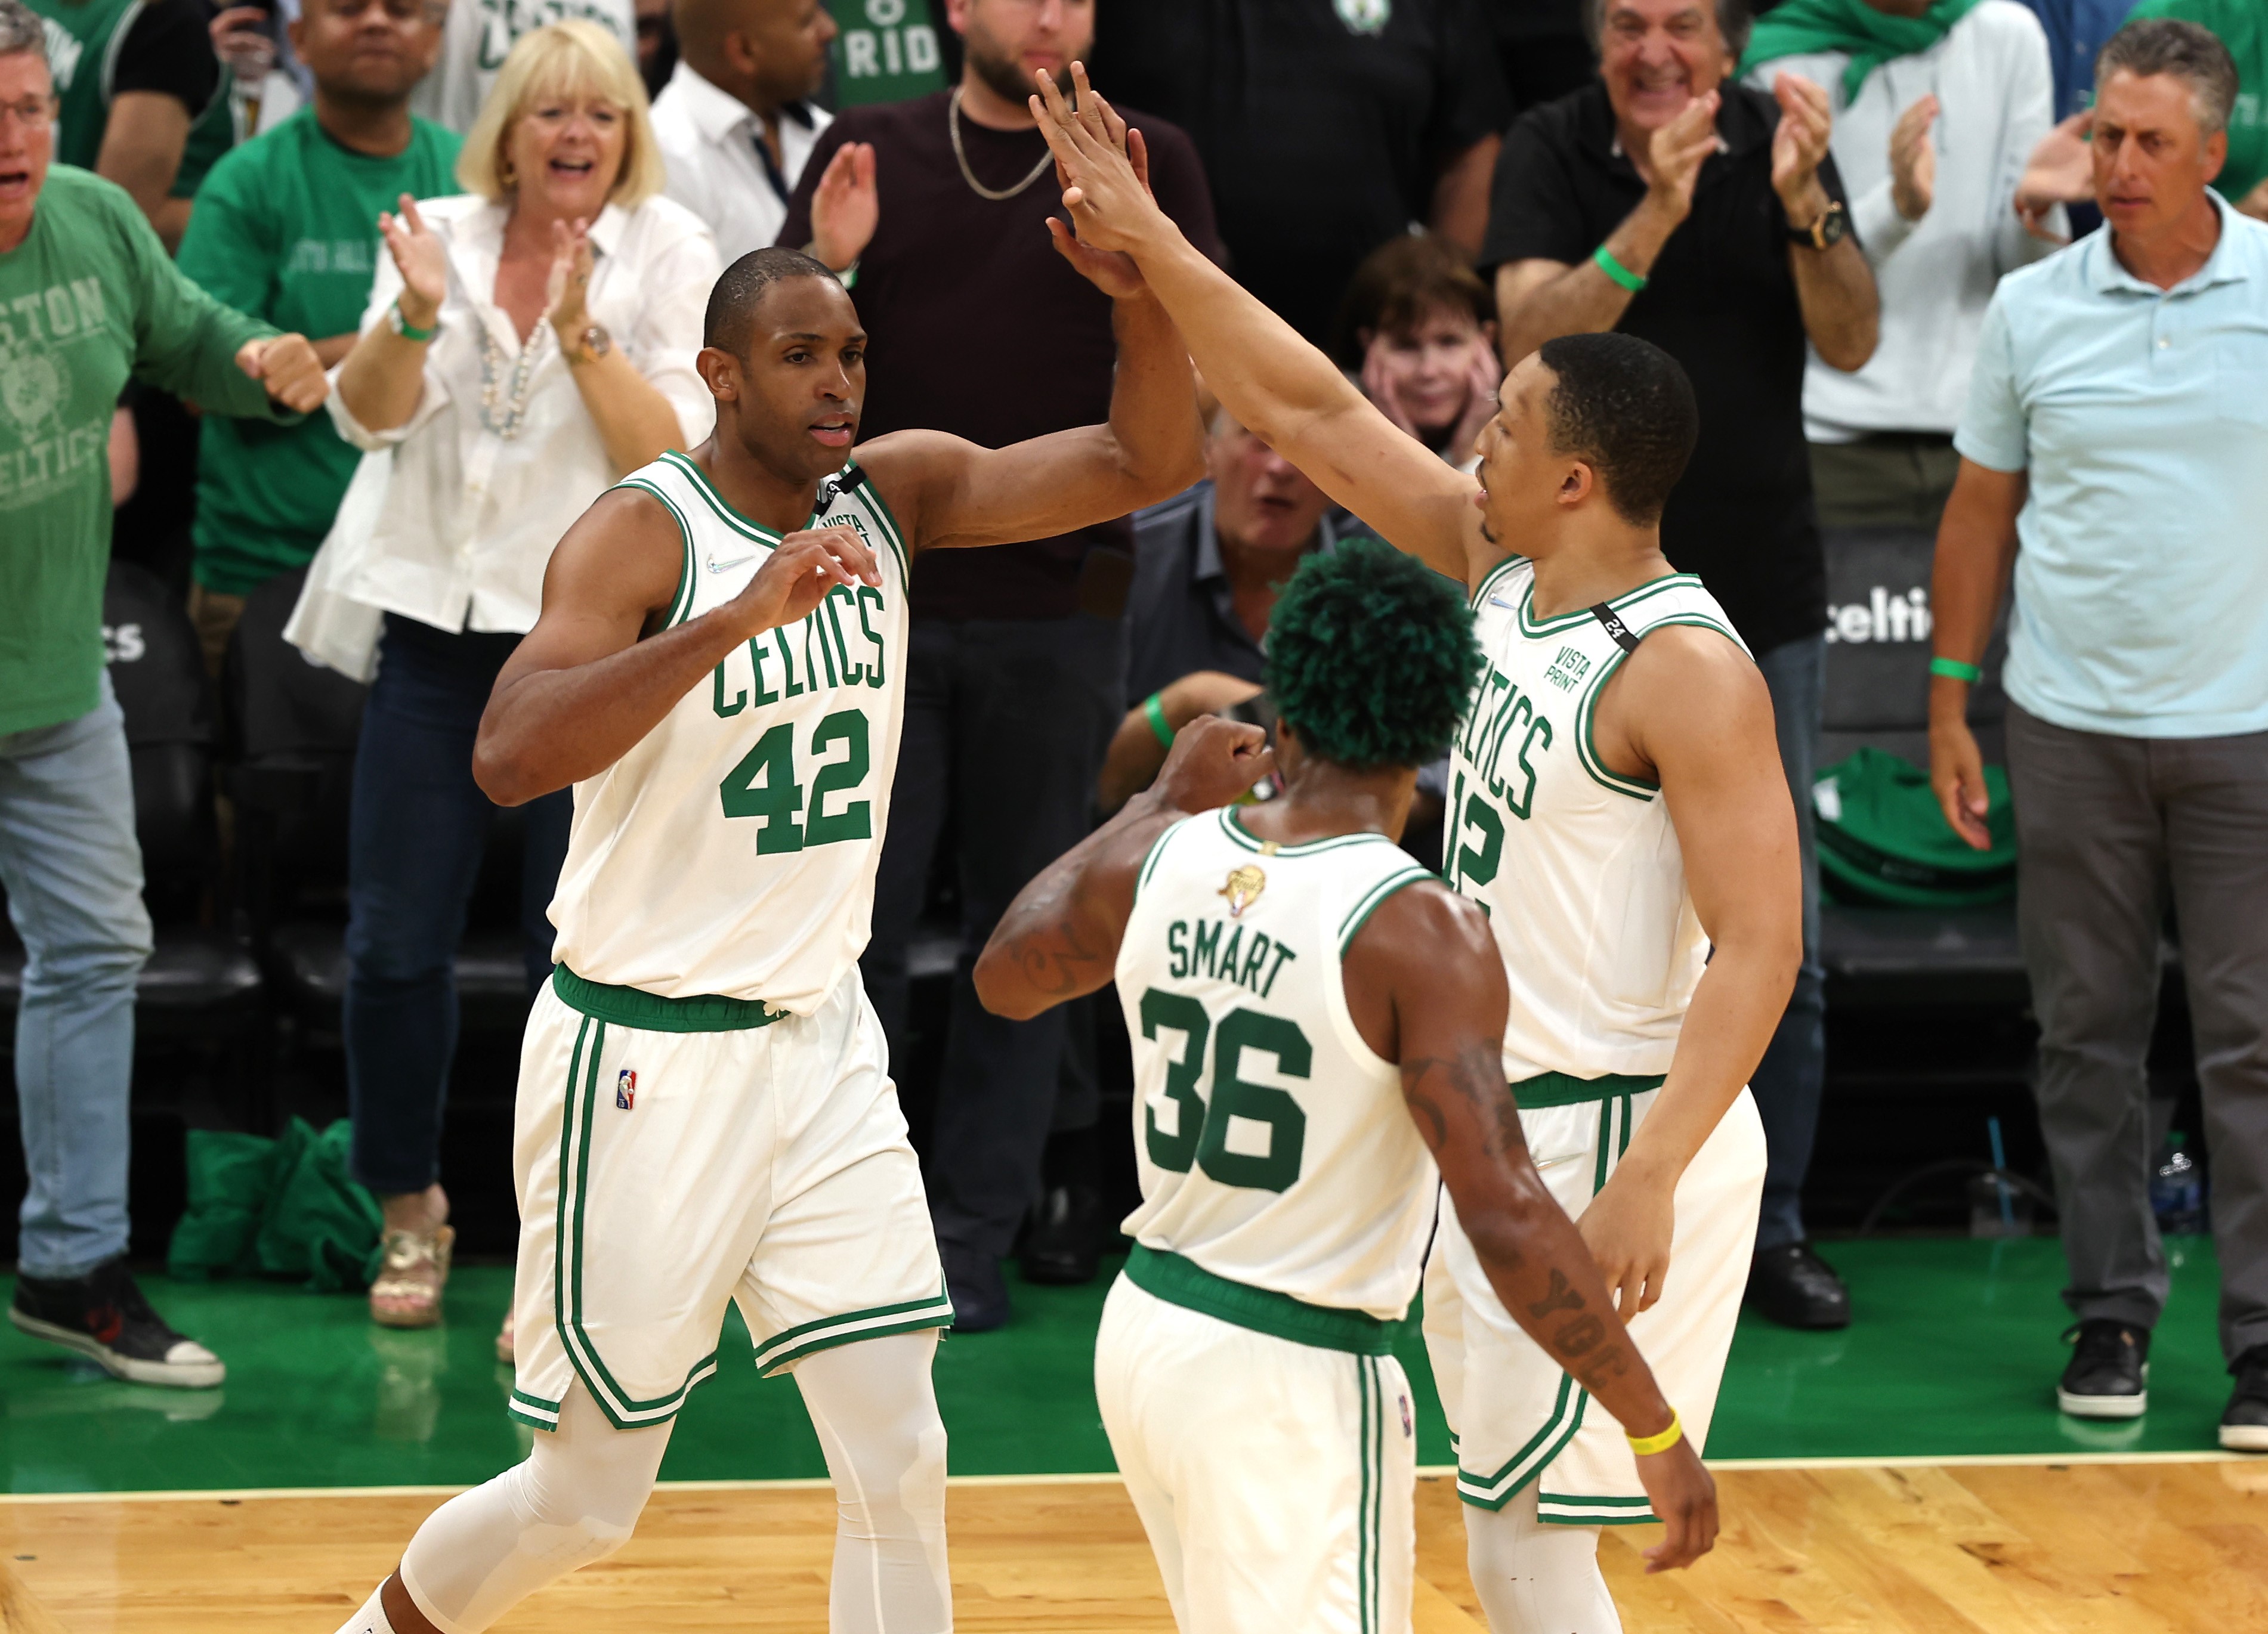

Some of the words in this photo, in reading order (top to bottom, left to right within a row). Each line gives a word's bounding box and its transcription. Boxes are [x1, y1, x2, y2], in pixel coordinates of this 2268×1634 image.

[1605, 618, 1626, 639] 24
[1824, 585, 1935, 644] elti
[713, 583, 885, 719] CELTICS
[1543, 665, 1579, 694] PRINT
[1555, 646, 1591, 680] VISTA
[719, 708, 872, 856] 42
[1168, 919, 1297, 999] SMART
[1139, 987, 1313, 1194] 36
